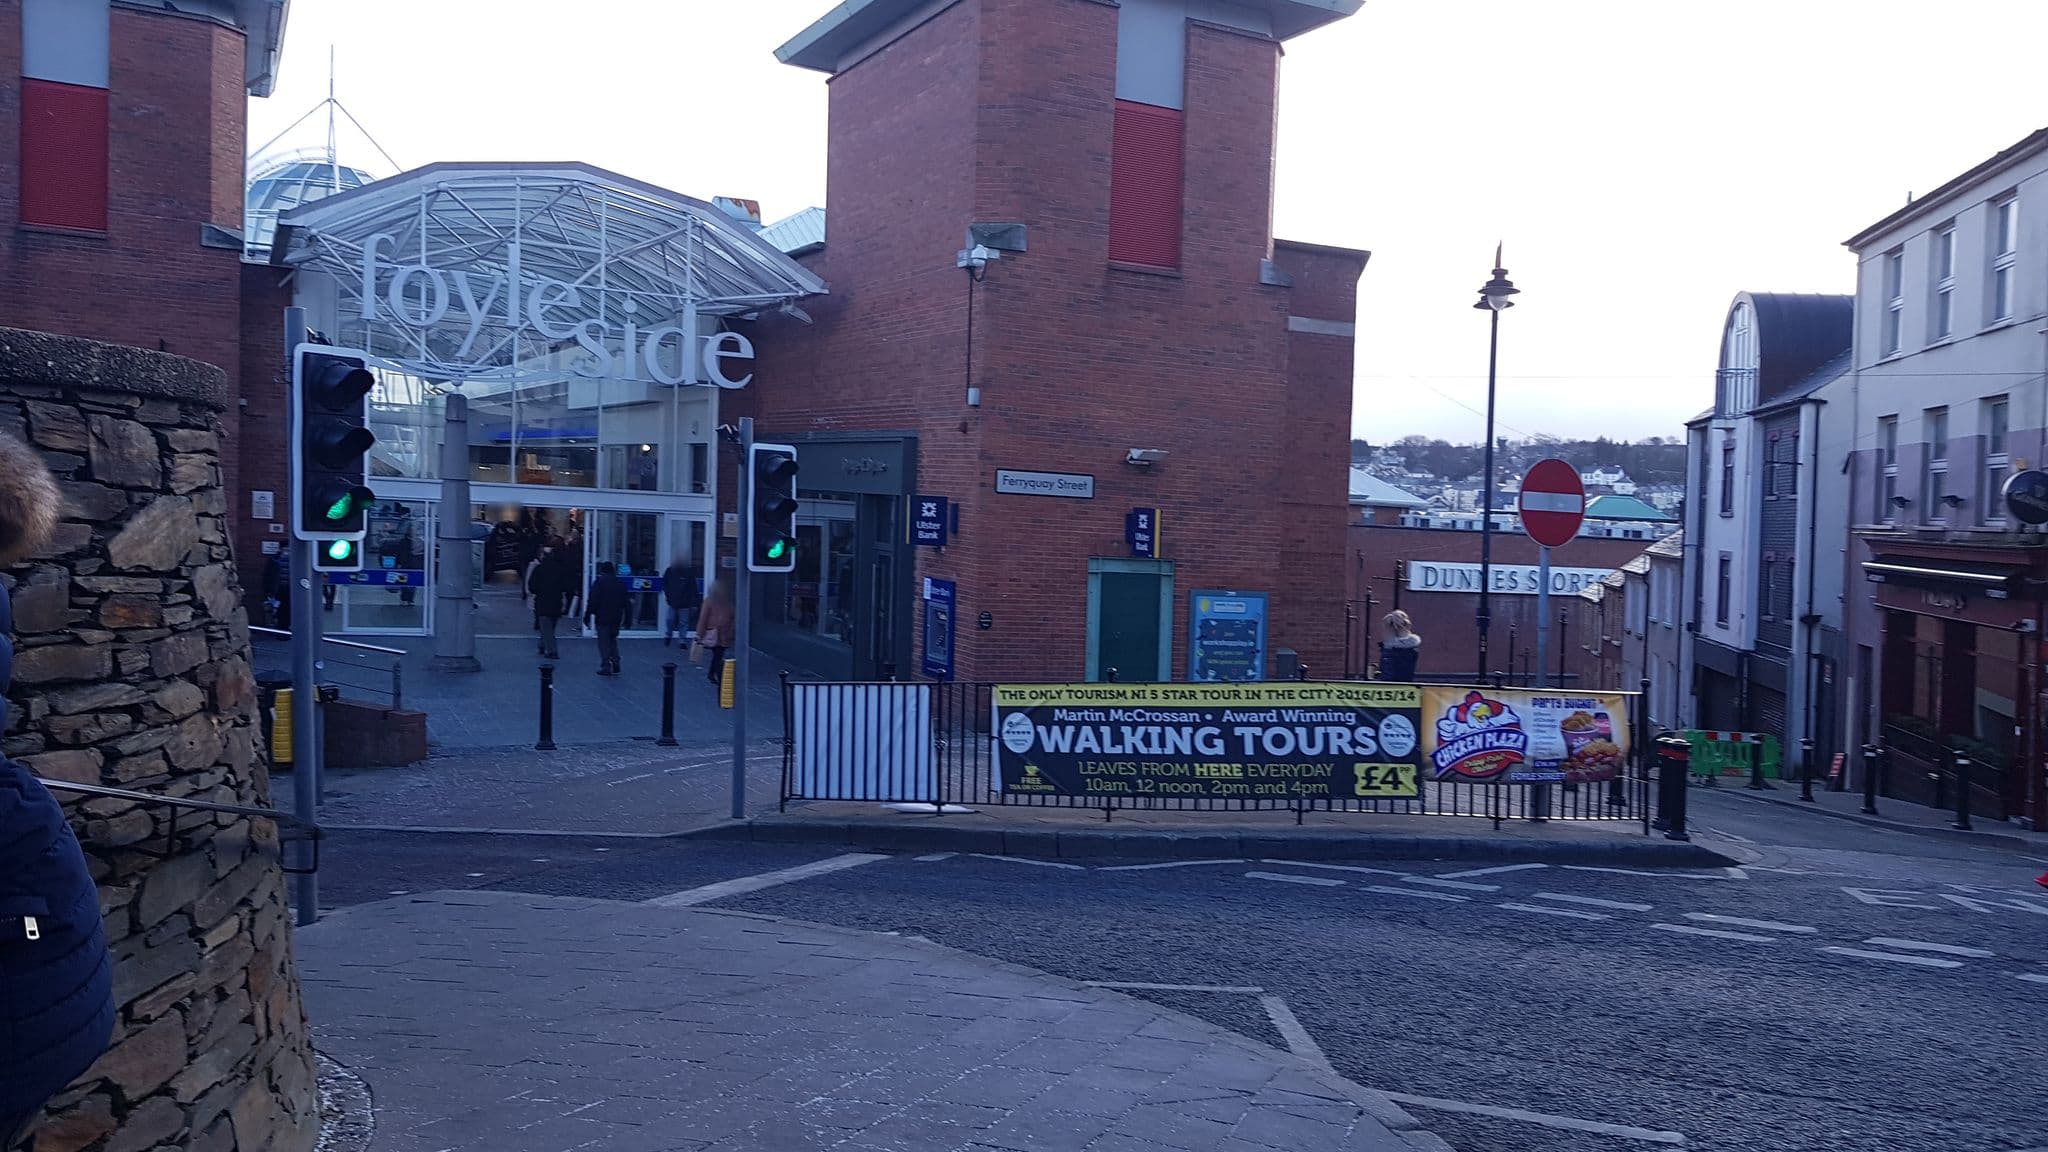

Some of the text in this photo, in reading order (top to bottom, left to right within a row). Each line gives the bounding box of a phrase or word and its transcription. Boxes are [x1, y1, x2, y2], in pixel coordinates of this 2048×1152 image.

[358, 233, 581, 357] foyle
[570, 296, 755, 390] side
[1002, 474, 1088, 491] Ferryquay Street
[916, 521, 941, 530] Ulster
[918, 531, 939, 539] Bank
[1527, 569, 1609, 592] SORE
[1000, 689, 1417, 702] THE ONLY TOURISM NI 5 STAR TOUR IN THE CITY 2016/15/14
[1053, 709, 1357, 726] Martin McCrossan Award Winning
[1037, 726, 1378, 756] WALKING TOURS
[1436, 733, 1484, 768] CHICKEN
[1484, 732, 1525, 750] PLAZA
[1078, 761, 1335, 778] LEAVES FROM HERE EVERYDAY
[1360, 766, 1404, 791] £4
[1020, 777, 1042, 785] FREE
[1085, 778, 1330, 797] 10am, 12 noon, 2pm and 4pm
